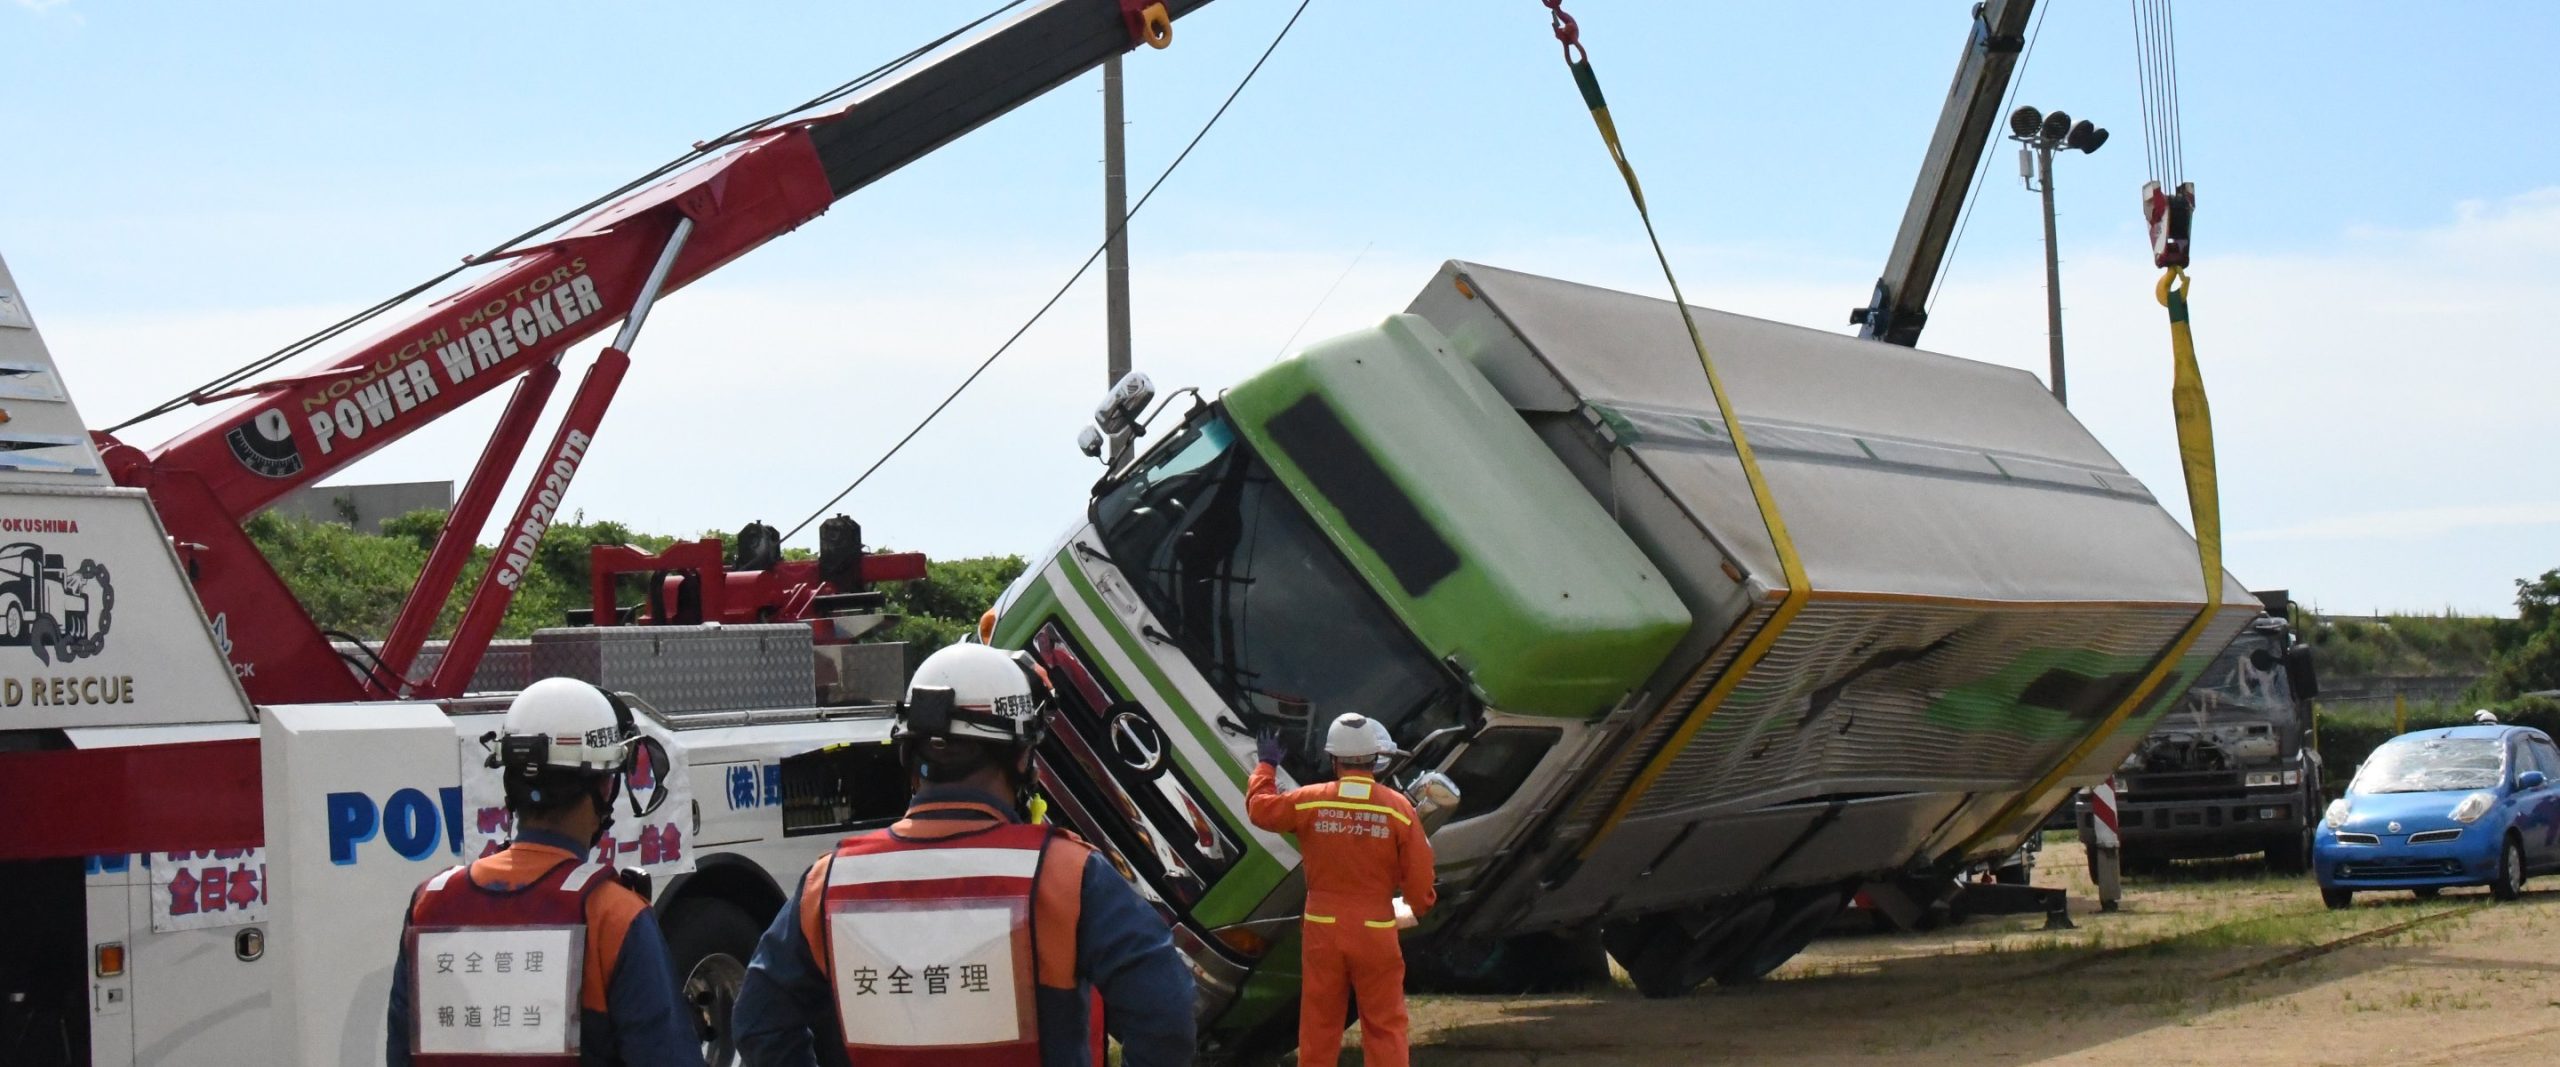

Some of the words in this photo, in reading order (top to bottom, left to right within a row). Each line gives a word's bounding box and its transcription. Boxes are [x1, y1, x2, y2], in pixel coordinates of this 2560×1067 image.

[302, 327, 449, 414] NOGUCHI
[459, 257, 587, 332] MOTORS
[307, 358, 441, 456] POWER
[436, 273, 603, 386] WRECKER
[0, 518, 79, 534] OKUSHIMA
[496, 428, 591, 592] SADR2020TR
[31, 674, 135, 706] RESCUE
[1314, 820, 1390, 839] 全日本レッカー協会
[436, 950, 545, 975] 安全管理
[853, 964, 991, 996] 安全管理
[437, 1004, 542, 1028] 報道担当
